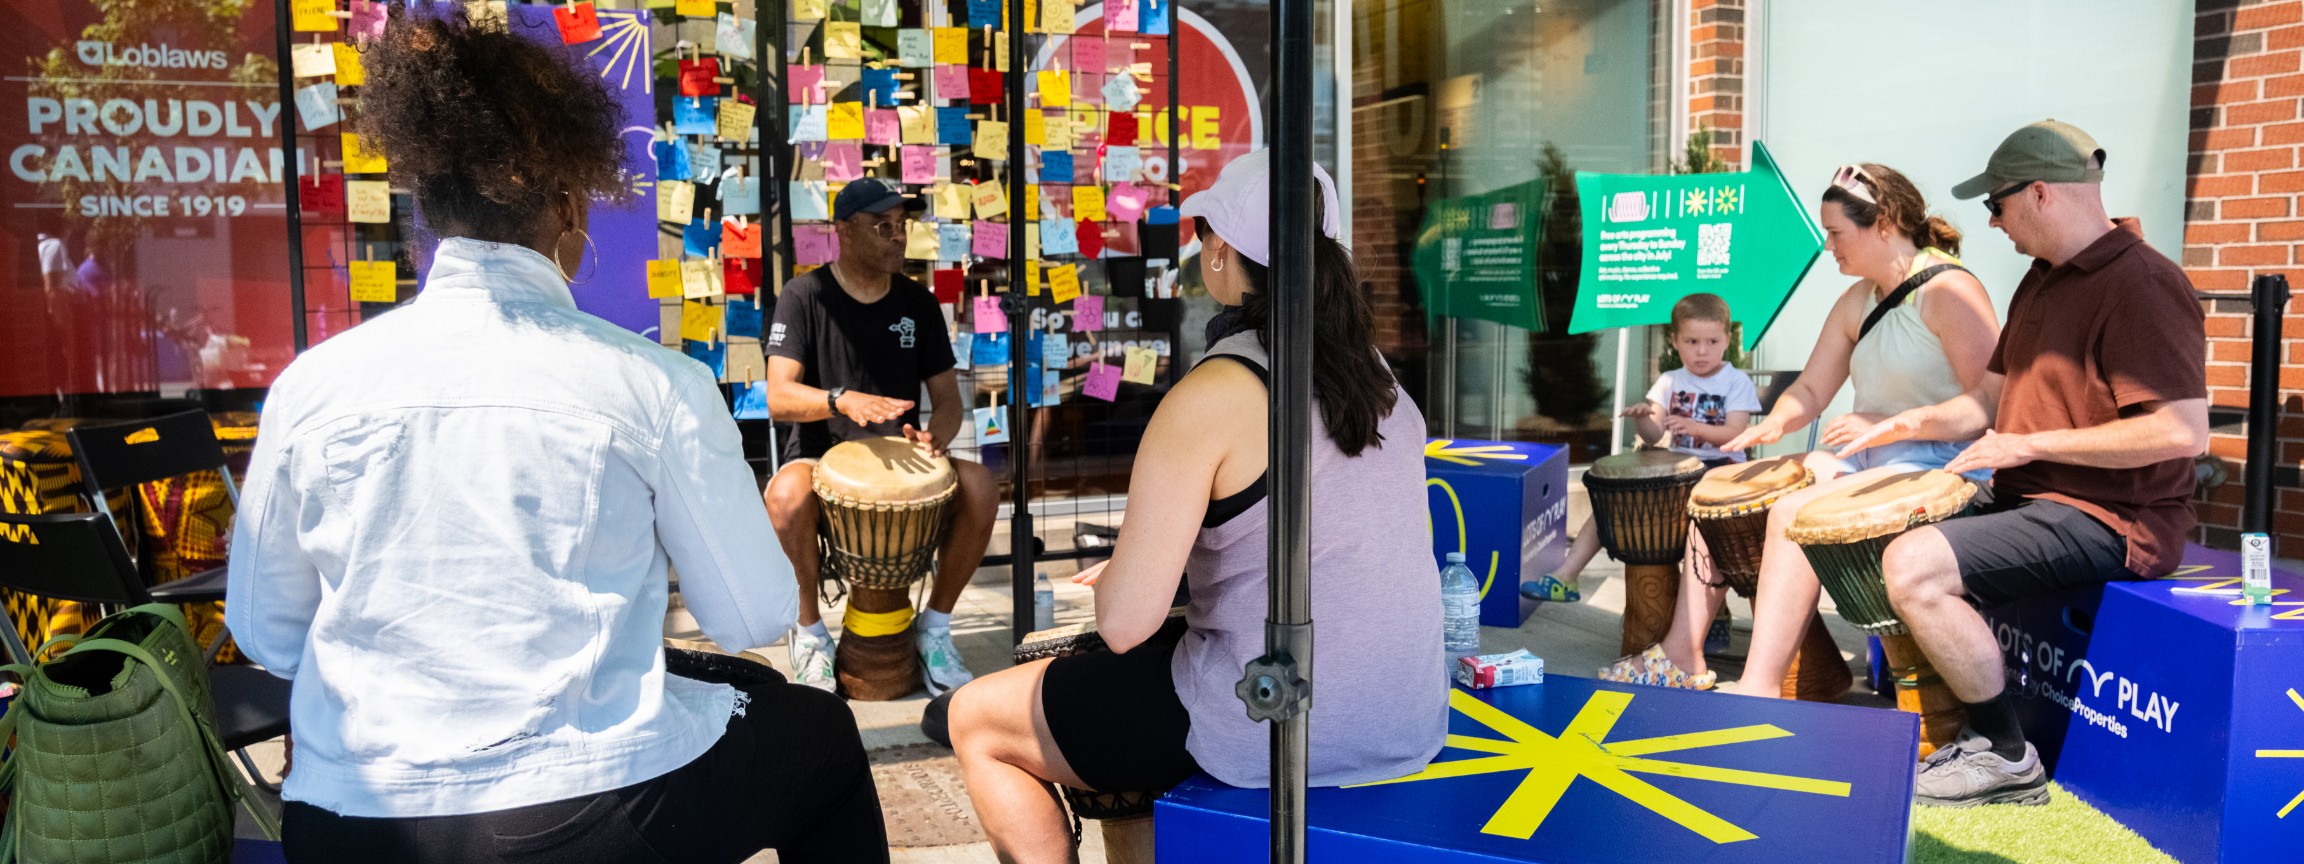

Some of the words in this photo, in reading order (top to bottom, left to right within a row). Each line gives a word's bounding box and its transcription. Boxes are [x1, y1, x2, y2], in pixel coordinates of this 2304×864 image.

[105, 41, 228, 70] Loblaws
[27, 97, 281, 138] PROUDLY
[1065, 102, 1221, 150] PICE
[9, 144, 306, 184] CANADIAN
[80, 196, 170, 217] SINCE
[179, 195, 246, 217] 1919
[1030, 307, 1065, 330] So
[2036, 641, 2065, 677] OF
[2117, 676, 2180, 734] PLAY
